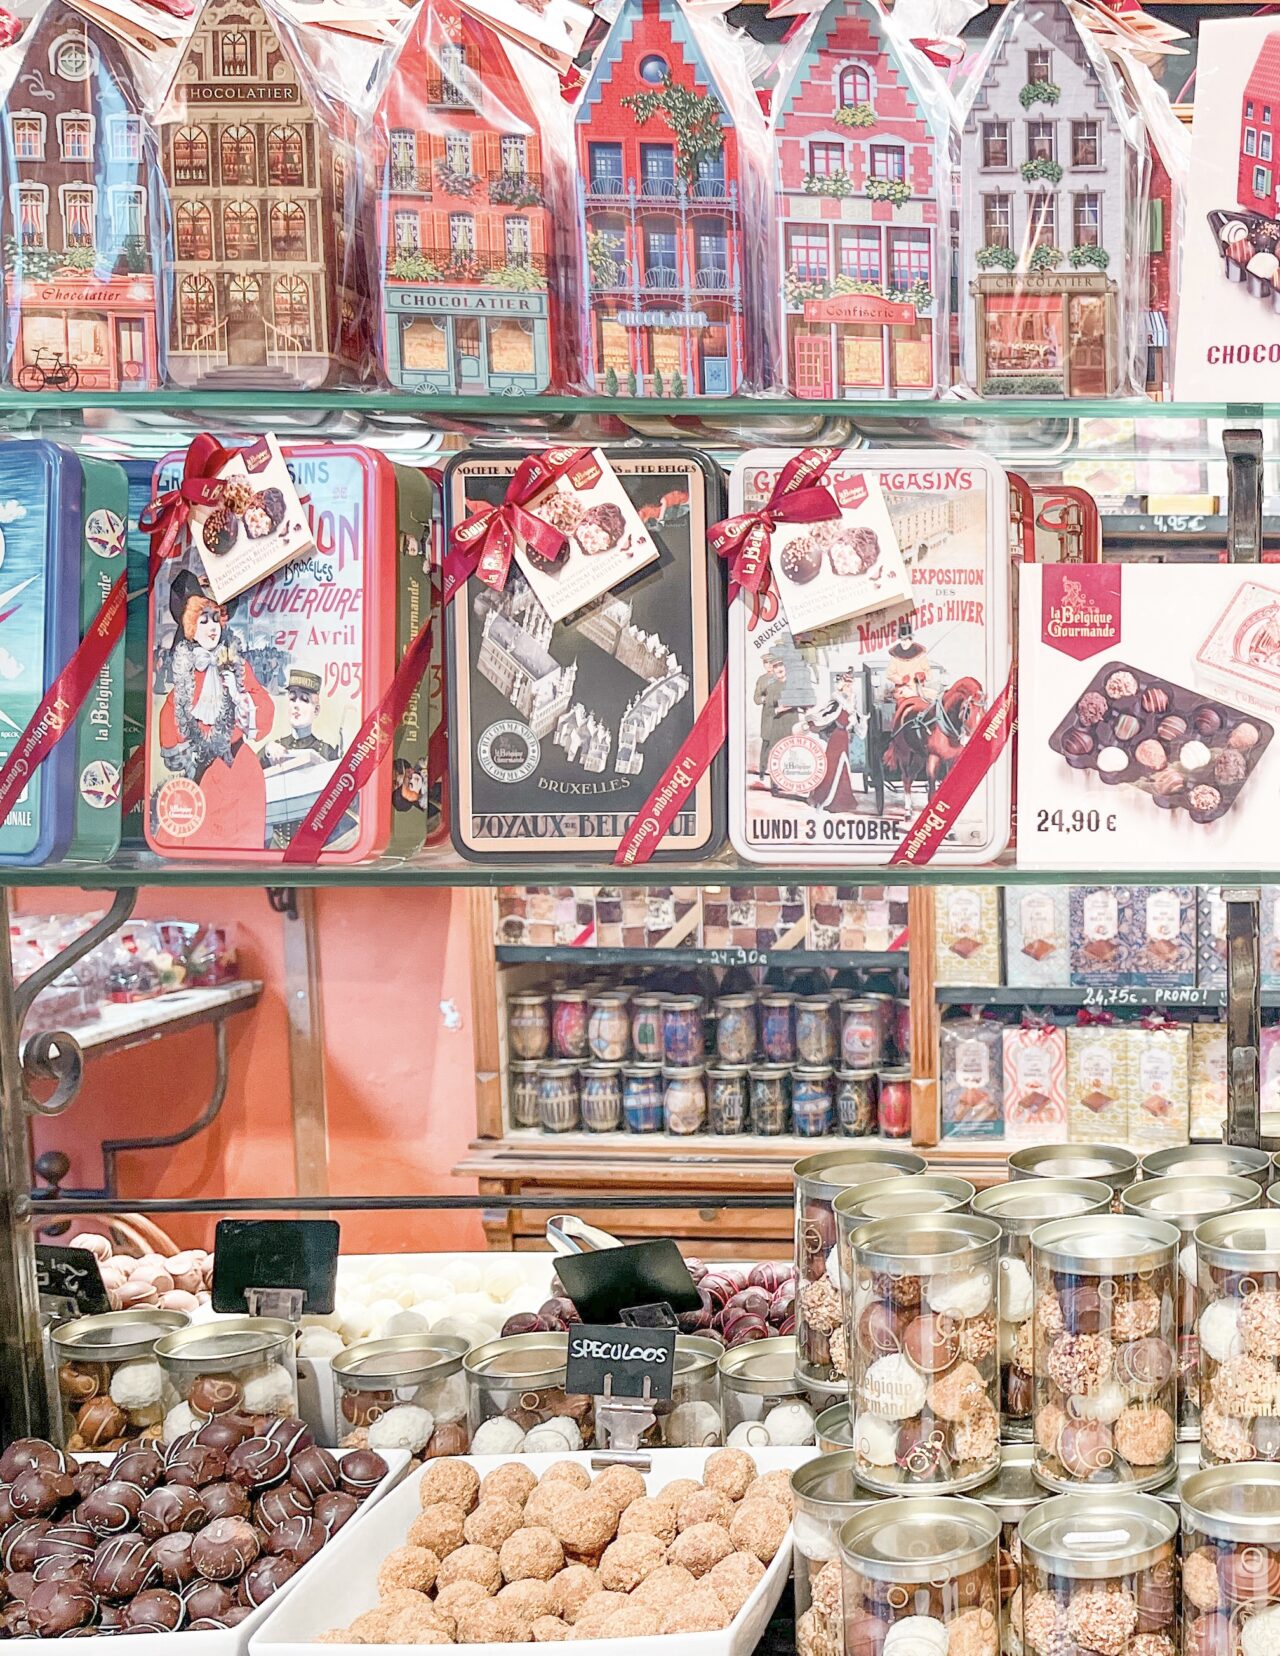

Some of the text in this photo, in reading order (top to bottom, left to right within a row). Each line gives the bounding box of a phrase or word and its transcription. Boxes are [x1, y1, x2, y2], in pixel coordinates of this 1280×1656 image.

[41, 287, 122, 304] Chocolatier
[400, 293, 531, 311] CHOCOLATIER
[657, 465, 697, 474] BELGES
[878, 470, 972, 490] AGASINS
[911, 568, 984, 585] EXPOSITION
[249, 581, 363, 620] OUVERTURE
[1050, 606, 1113, 628] la Belgique
[275, 625, 356, 651] 27 Avril
[753, 617, 789, 649] BRUXELL
[1047, 619, 1116, 639] Gourmande
[95, 731, 109, 741] la
[683, 757, 697, 770] la
[538, 777, 631, 795] BRUXELLES
[654, 766, 693, 817] Belgique
[311, 774, 355, 832] Gourmande
[472, 815, 566, 838] JOYAUX
[753, 819, 900, 841] LUNDI 3 OCTOBRE
[905, 800, 951, 860] la Belgique
[1037, 809, 1101, 835] 24,90
[570, 1338, 669, 1364] SPECULOOS
[863, 1374, 913, 1398] elgique
